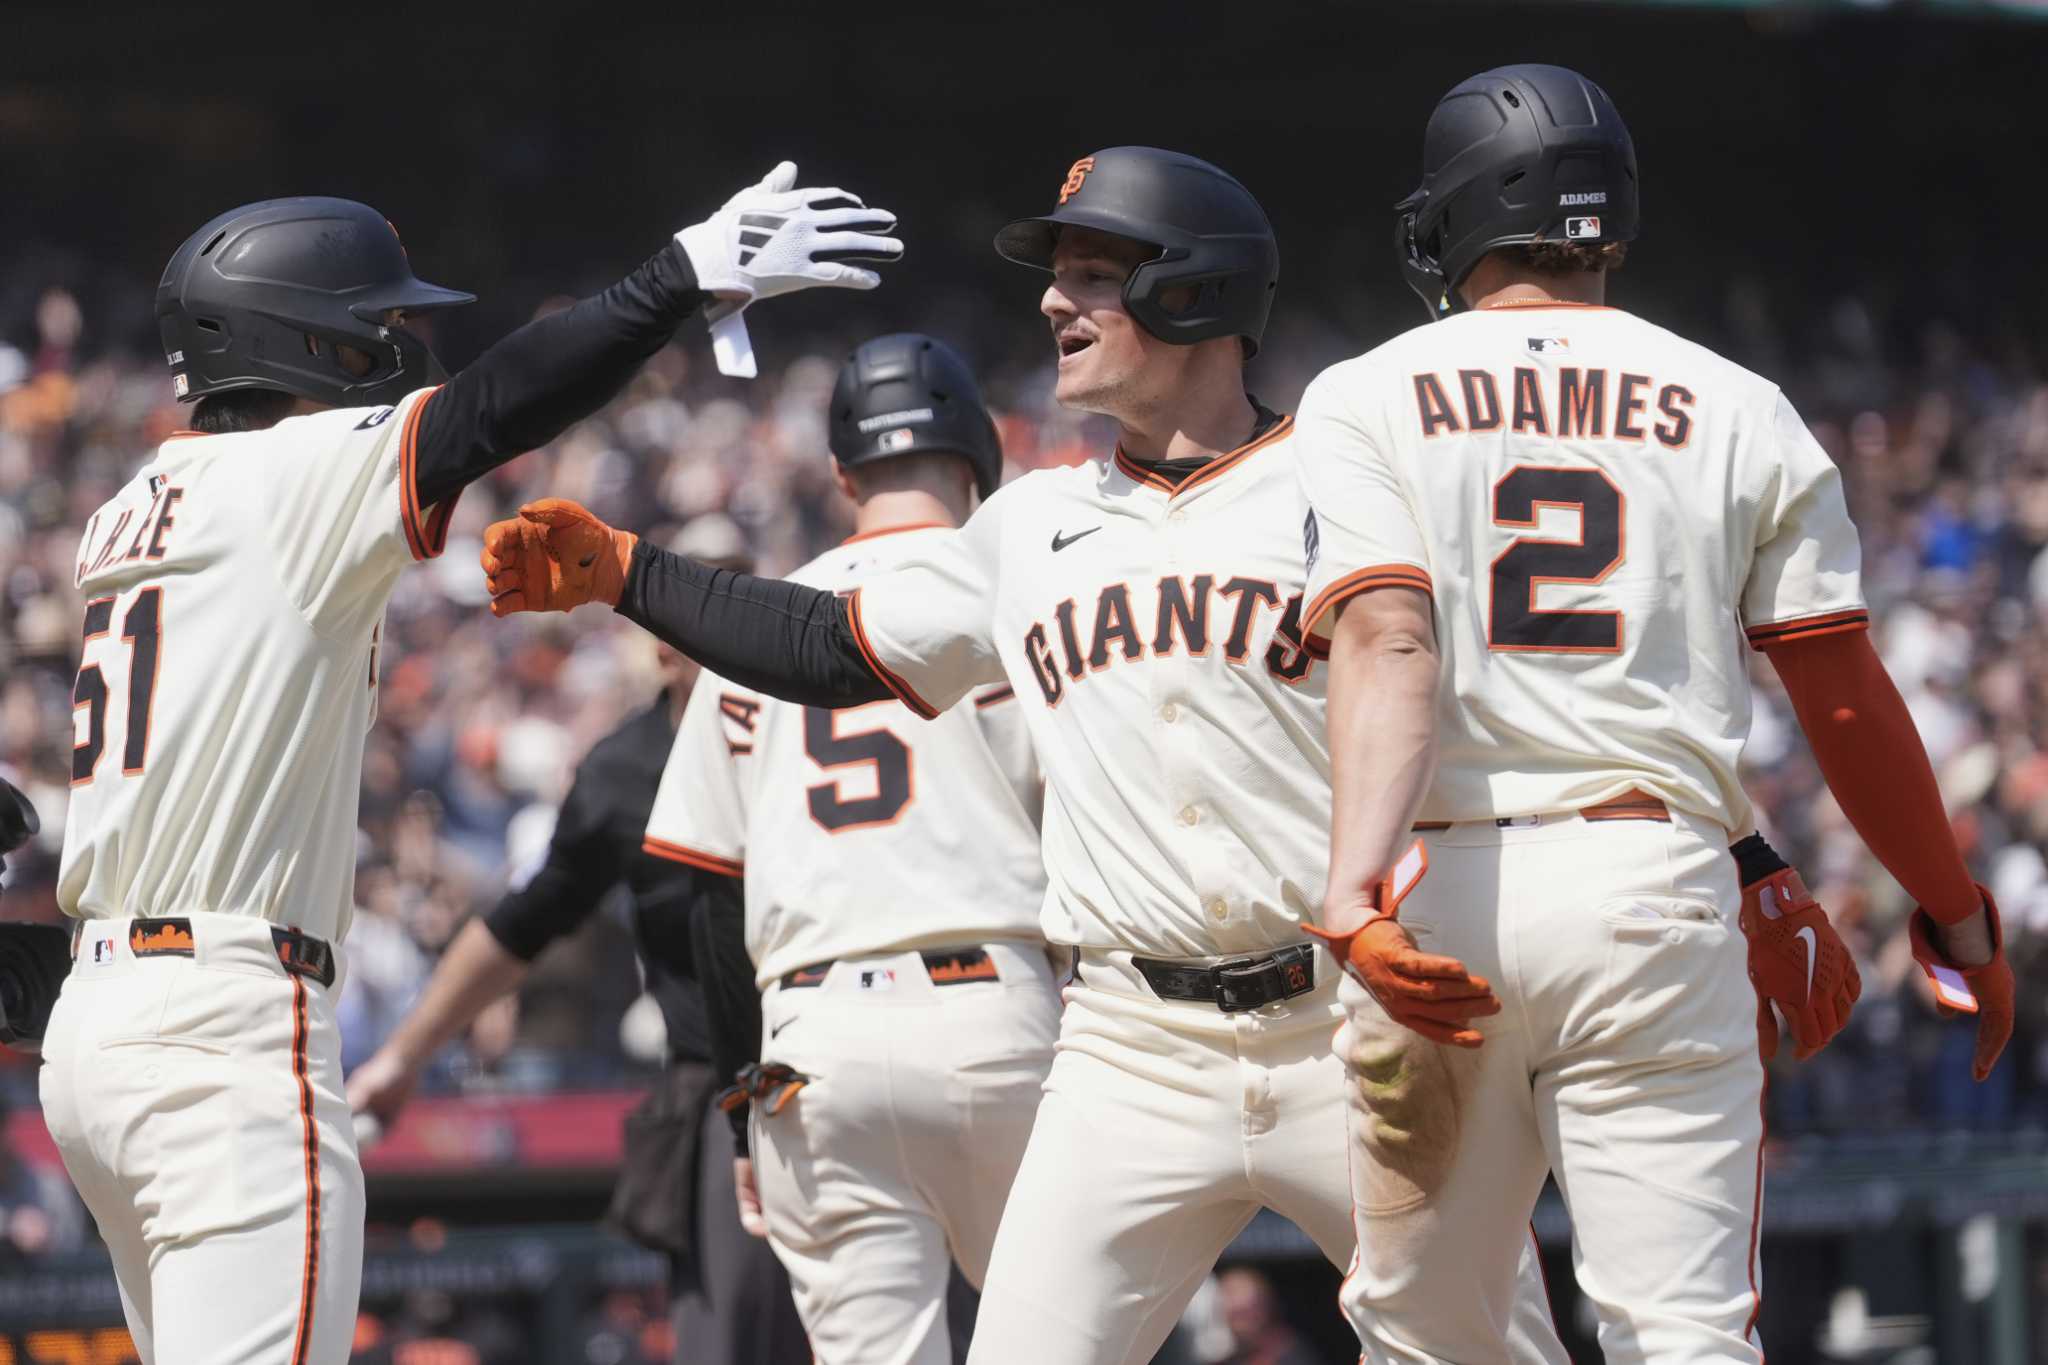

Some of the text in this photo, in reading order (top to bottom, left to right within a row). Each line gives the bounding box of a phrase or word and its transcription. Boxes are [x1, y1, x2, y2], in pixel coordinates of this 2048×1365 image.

[1559, 191, 1607, 206] ADAMES
[1413, 365, 1697, 451] ADAMES
[1488, 464, 1625, 654] 2
[69, 585, 164, 785] 51
[1024, 572, 1312, 709] GIANTS
[801, 698, 914, 835] 5
